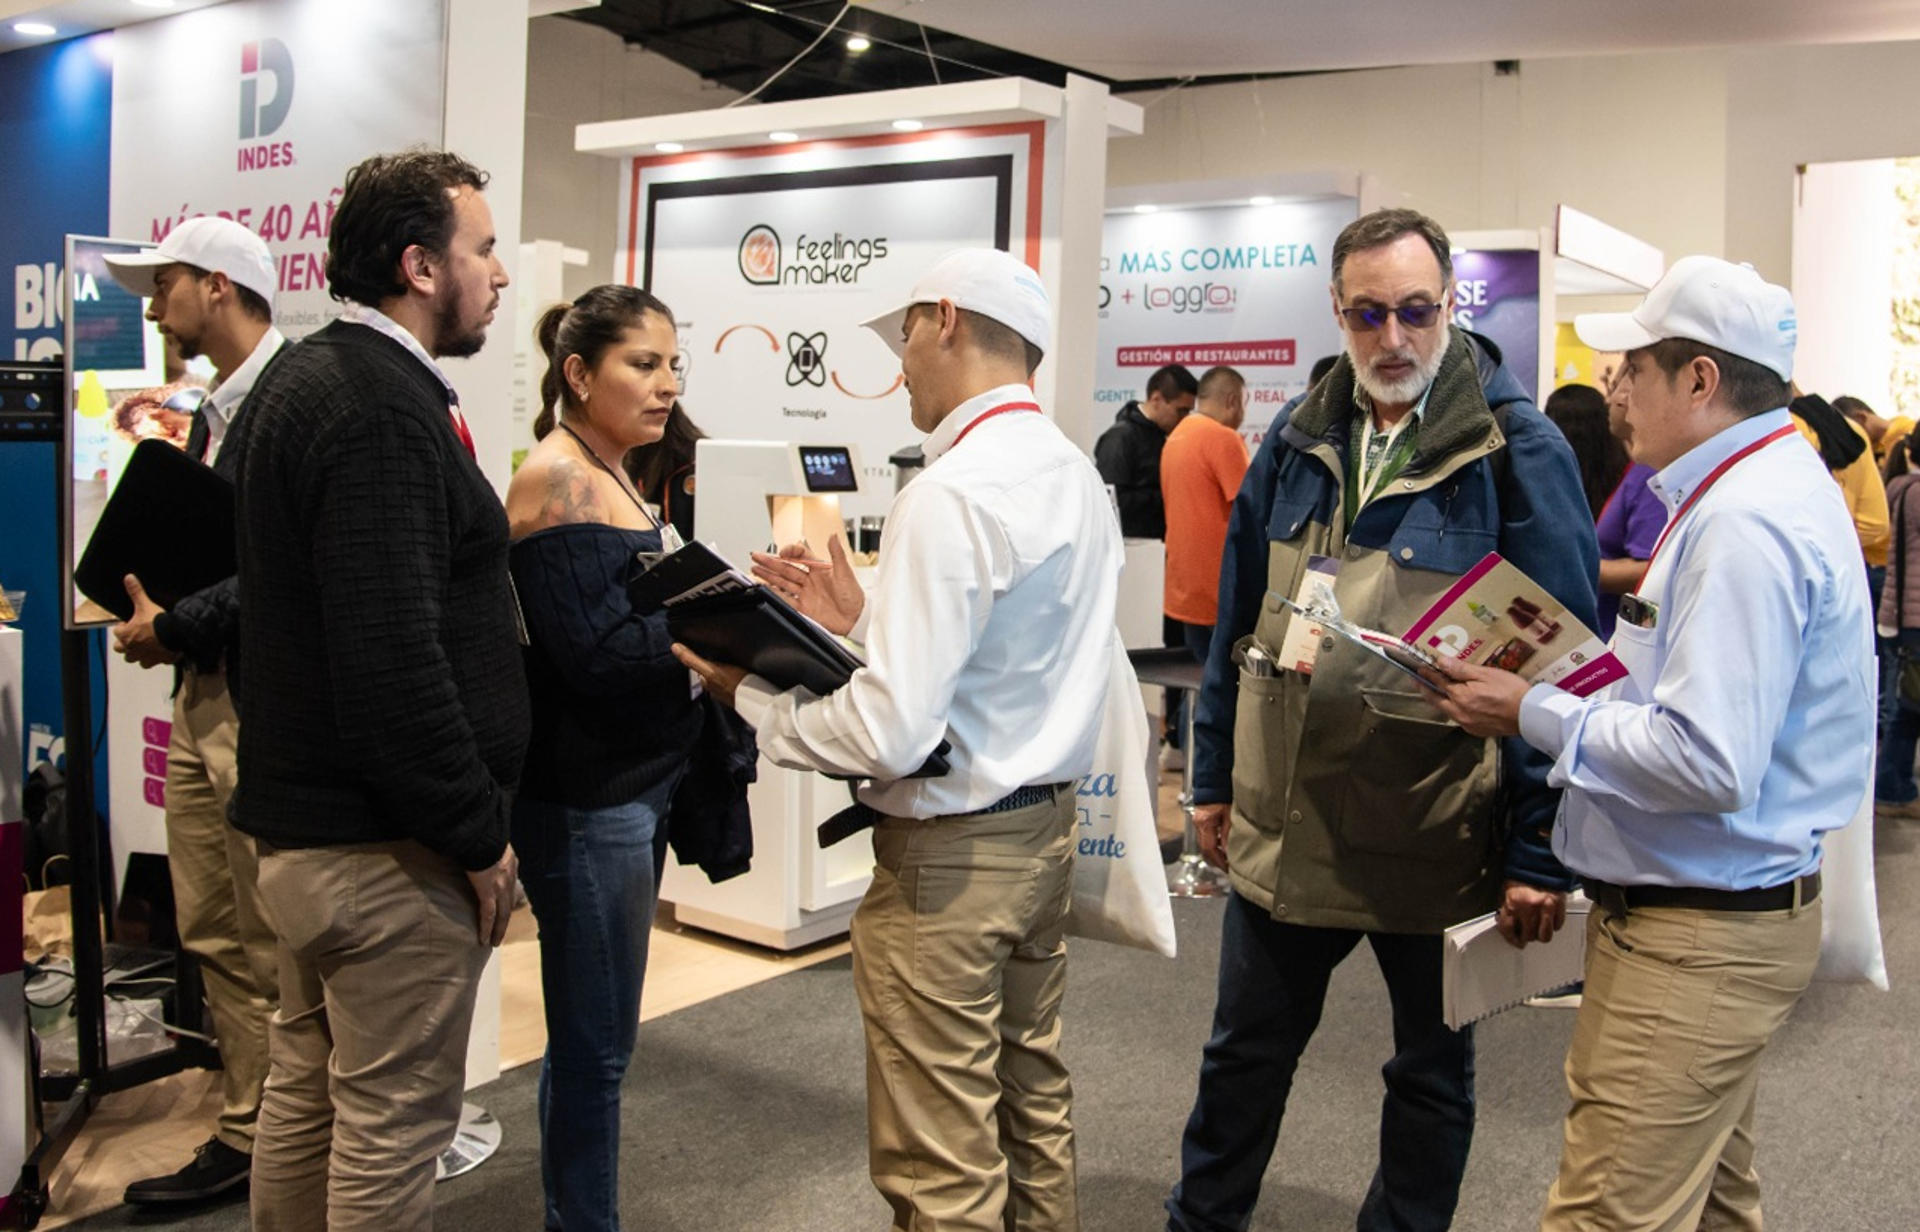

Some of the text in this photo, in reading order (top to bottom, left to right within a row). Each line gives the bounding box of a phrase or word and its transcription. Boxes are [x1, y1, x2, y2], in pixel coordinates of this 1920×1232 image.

[237, 142, 293, 171] INDES
[259, 204, 292, 242] 40
[796, 232, 888, 270] feelings
[1180, 243, 1317, 272] COMPLETA
[783, 254, 874, 285] maker
[1456, 279, 1488, 306] SE
[1119, 348, 1290, 362] GESTIÓN DE RESTAURANTES
